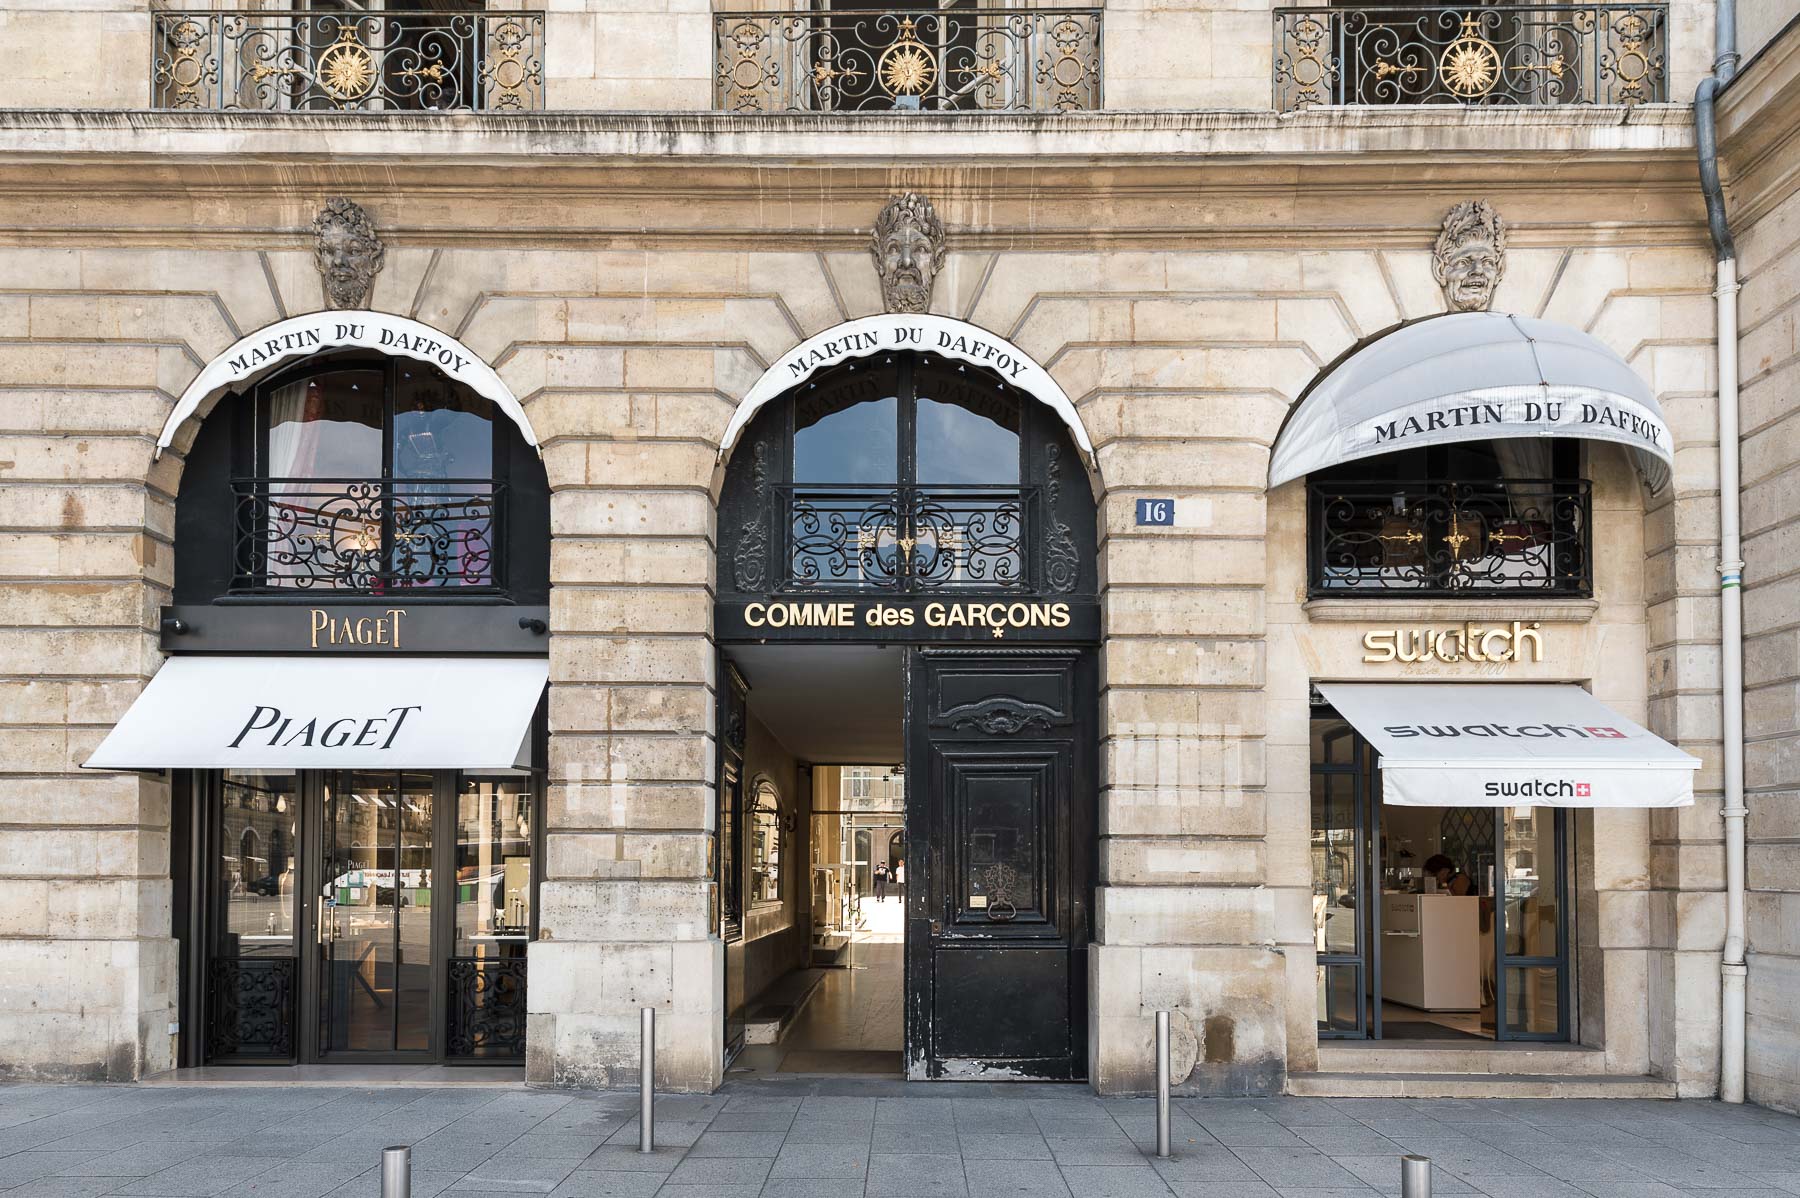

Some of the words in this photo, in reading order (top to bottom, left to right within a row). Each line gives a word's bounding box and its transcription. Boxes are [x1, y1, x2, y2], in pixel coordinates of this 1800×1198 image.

[228, 328, 321, 374] MARTIN
[335, 324, 365, 340] DU
[378, 328, 471, 373] DAFFOY
[787, 331, 878, 378] MARTIN
[894, 327, 923, 343] DU
[937, 330, 1028, 378] DAFFOY
[1374, 403, 1504, 444] MARTIN
[1524, 402, 1562, 422] DU
[1581, 403, 1661, 447] DAFFOY
[1145, 502, 1166, 522] 16
[310, 608, 407, 649] PIAGET
[744, 602, 855, 628] COMME
[865, 603, 915, 627] des
[924, 602, 1071, 639] GARÇONS
[1362, 620, 1543, 663] swatch
[226, 705, 422, 750] PIAGET
[1383, 722, 1590, 738] swatch
[1485, 779, 1574, 797] swatch
